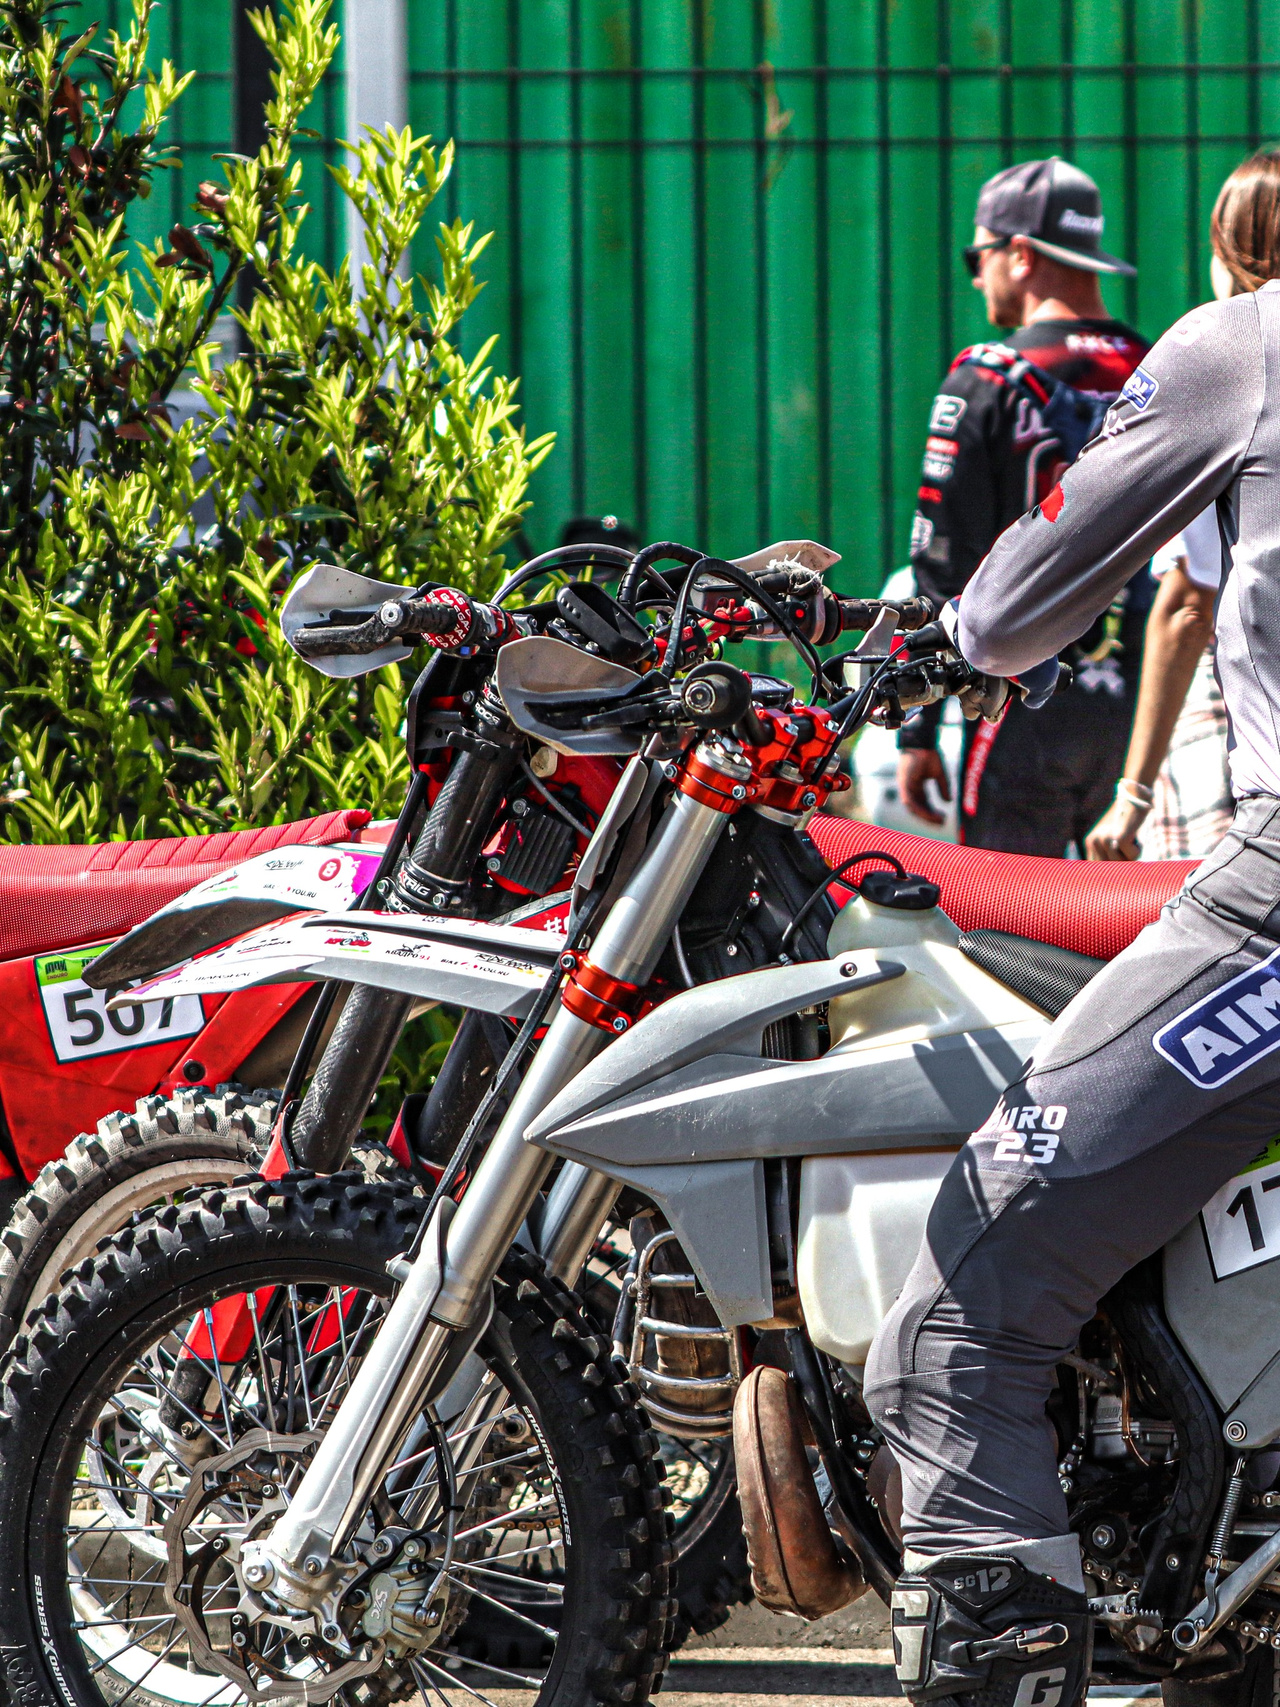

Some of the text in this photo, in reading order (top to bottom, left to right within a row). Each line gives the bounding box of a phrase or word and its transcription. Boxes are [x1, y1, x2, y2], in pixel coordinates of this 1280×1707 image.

[993, 1132, 1060, 1164] 23
[521, 1405, 555, 1466] ENDURO
[555, 1483, 572, 1546] SERIES
[34, 1574, 50, 1637] SERIES
